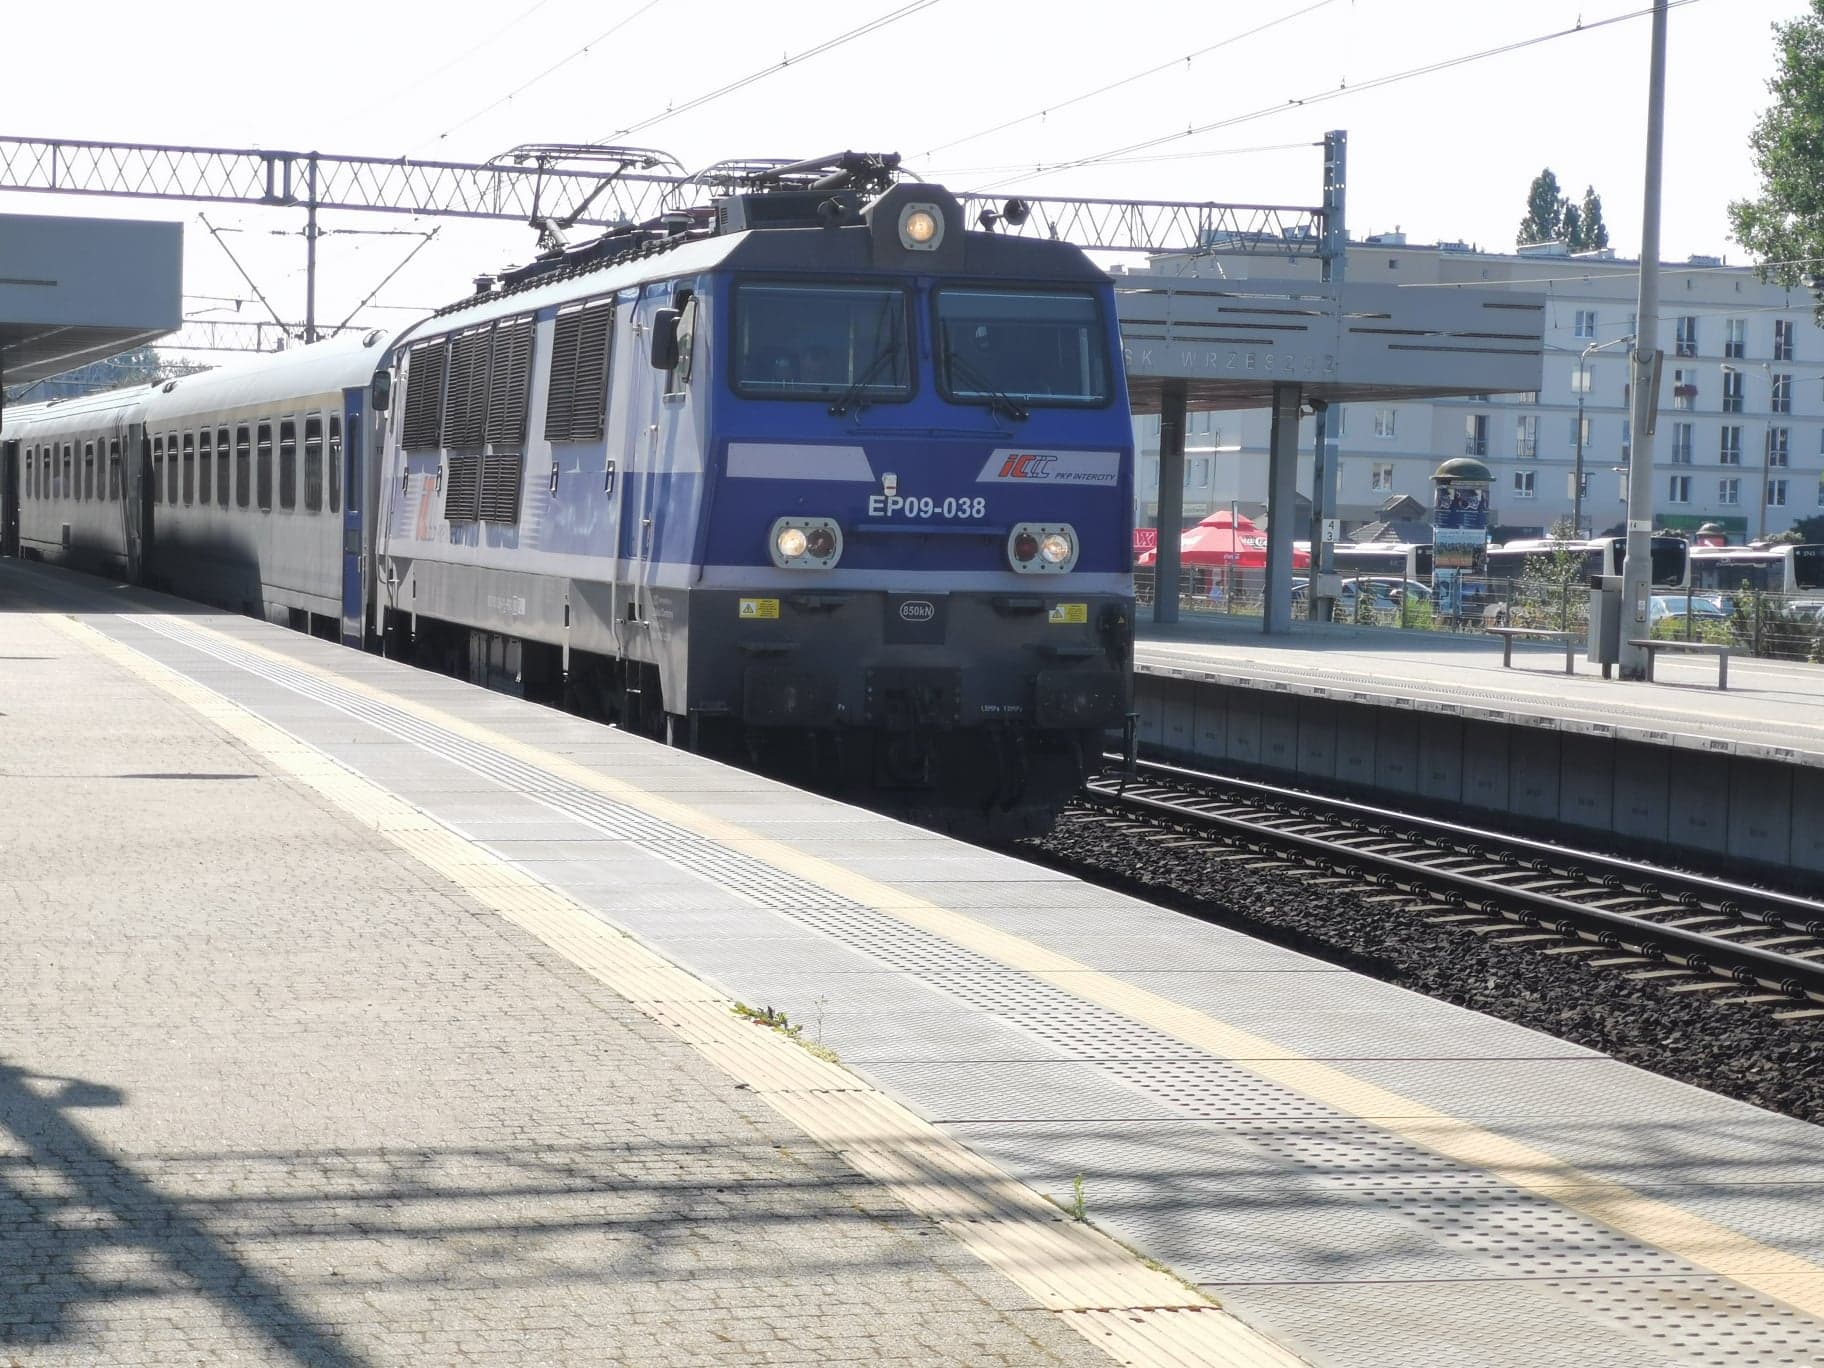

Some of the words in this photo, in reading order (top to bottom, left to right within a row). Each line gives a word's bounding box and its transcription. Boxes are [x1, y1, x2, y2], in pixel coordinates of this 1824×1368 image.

[1054, 472, 1073, 480] PKP
[1073, 473, 1117, 481] INTERCITY
[868, 495, 986, 519] EP09-038
[903, 606, 932, 616] 850kN
